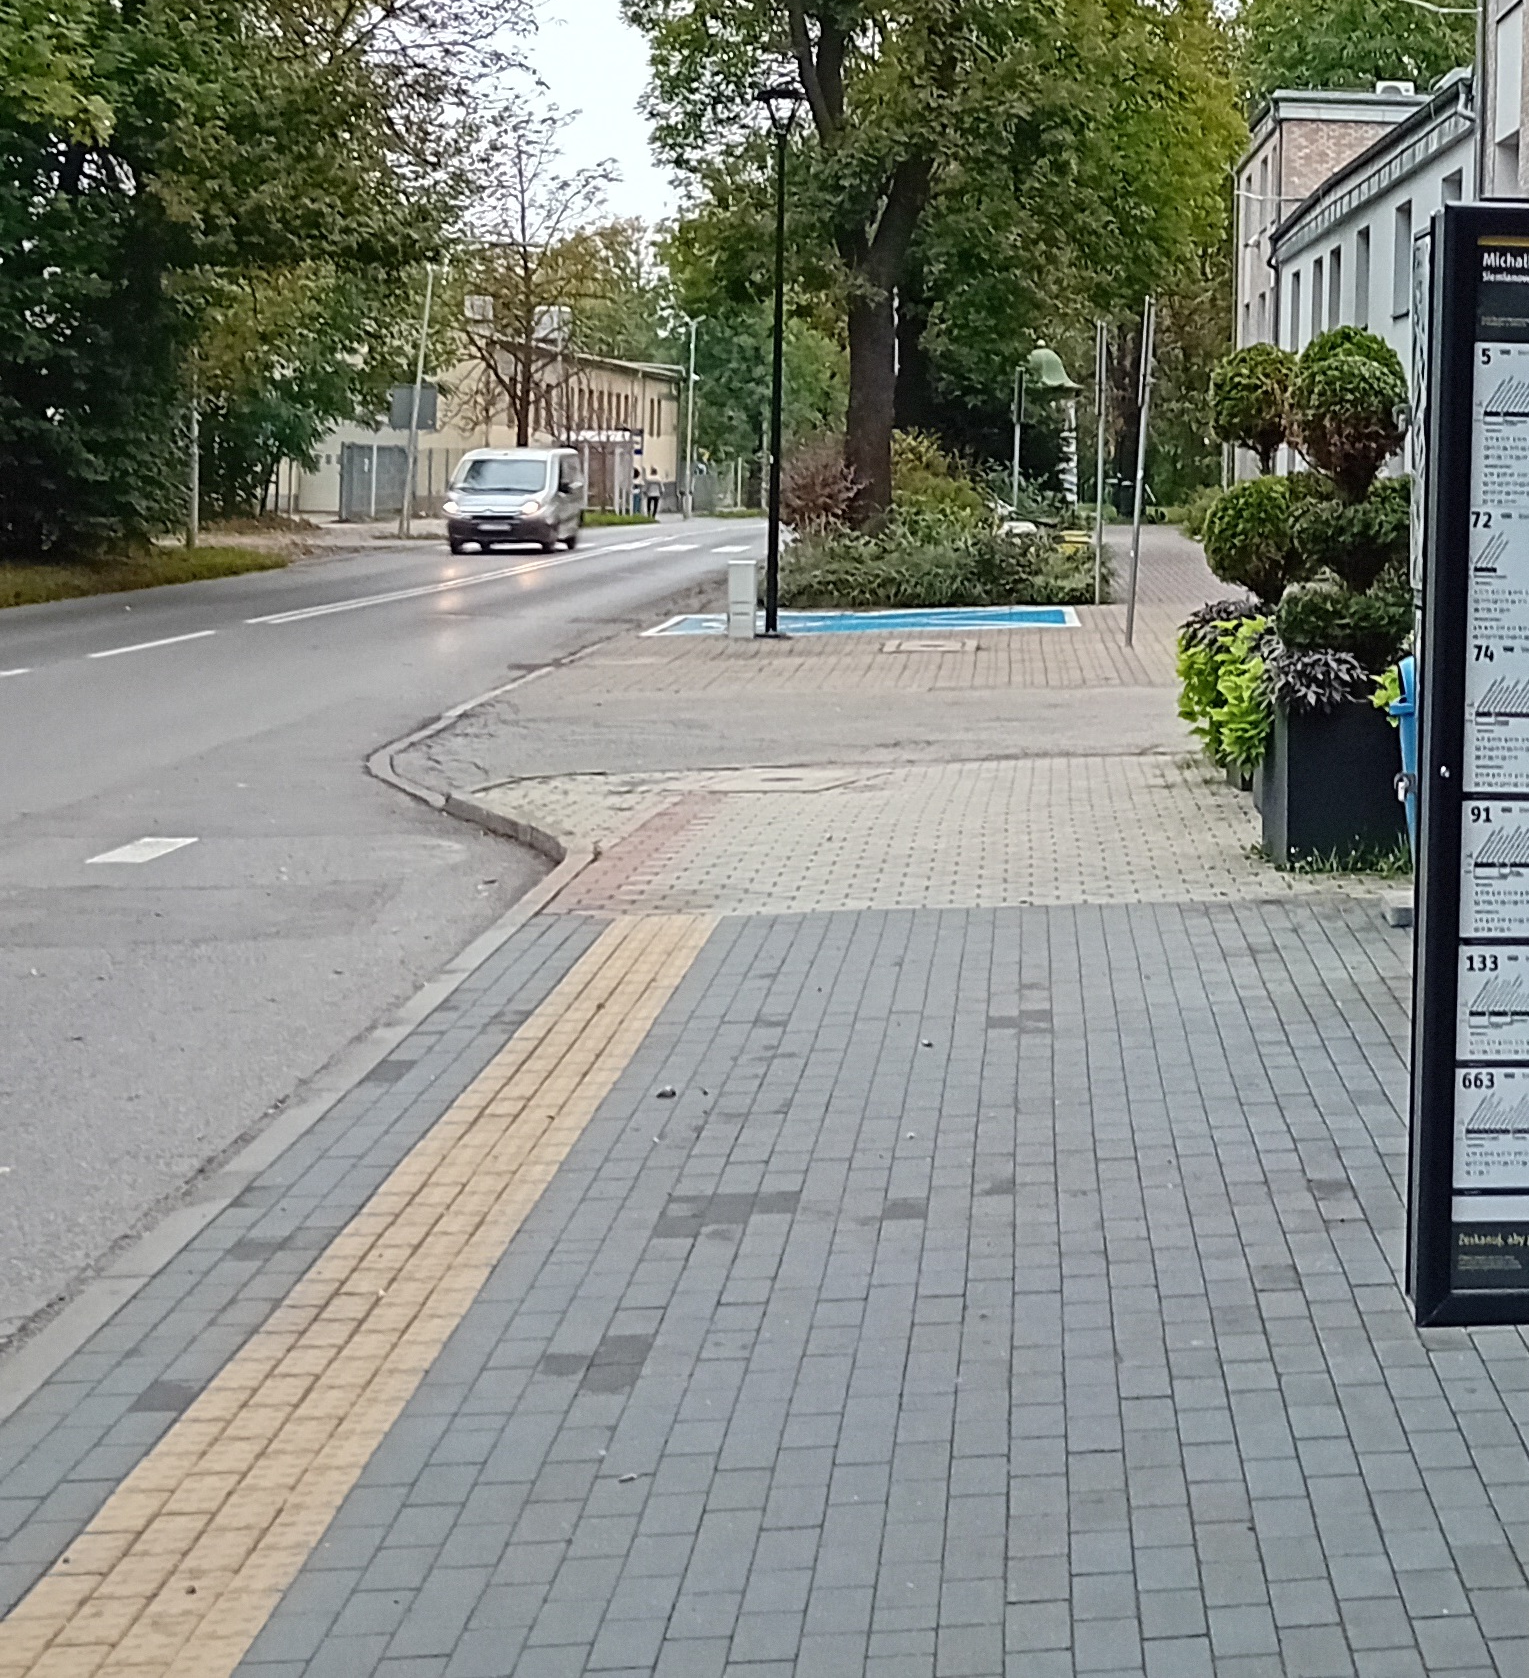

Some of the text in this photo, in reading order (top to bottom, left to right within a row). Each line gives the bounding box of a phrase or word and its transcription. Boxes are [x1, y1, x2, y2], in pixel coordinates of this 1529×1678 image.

[1481, 347, 1491, 365] 5
[1471, 510, 1493, 529] 72
[1473, 644, 1495, 663] 74
[1470, 806, 1493, 824] 91
[1466, 954, 1499, 972] 133
[1462, 1072, 1496, 1090] 663
